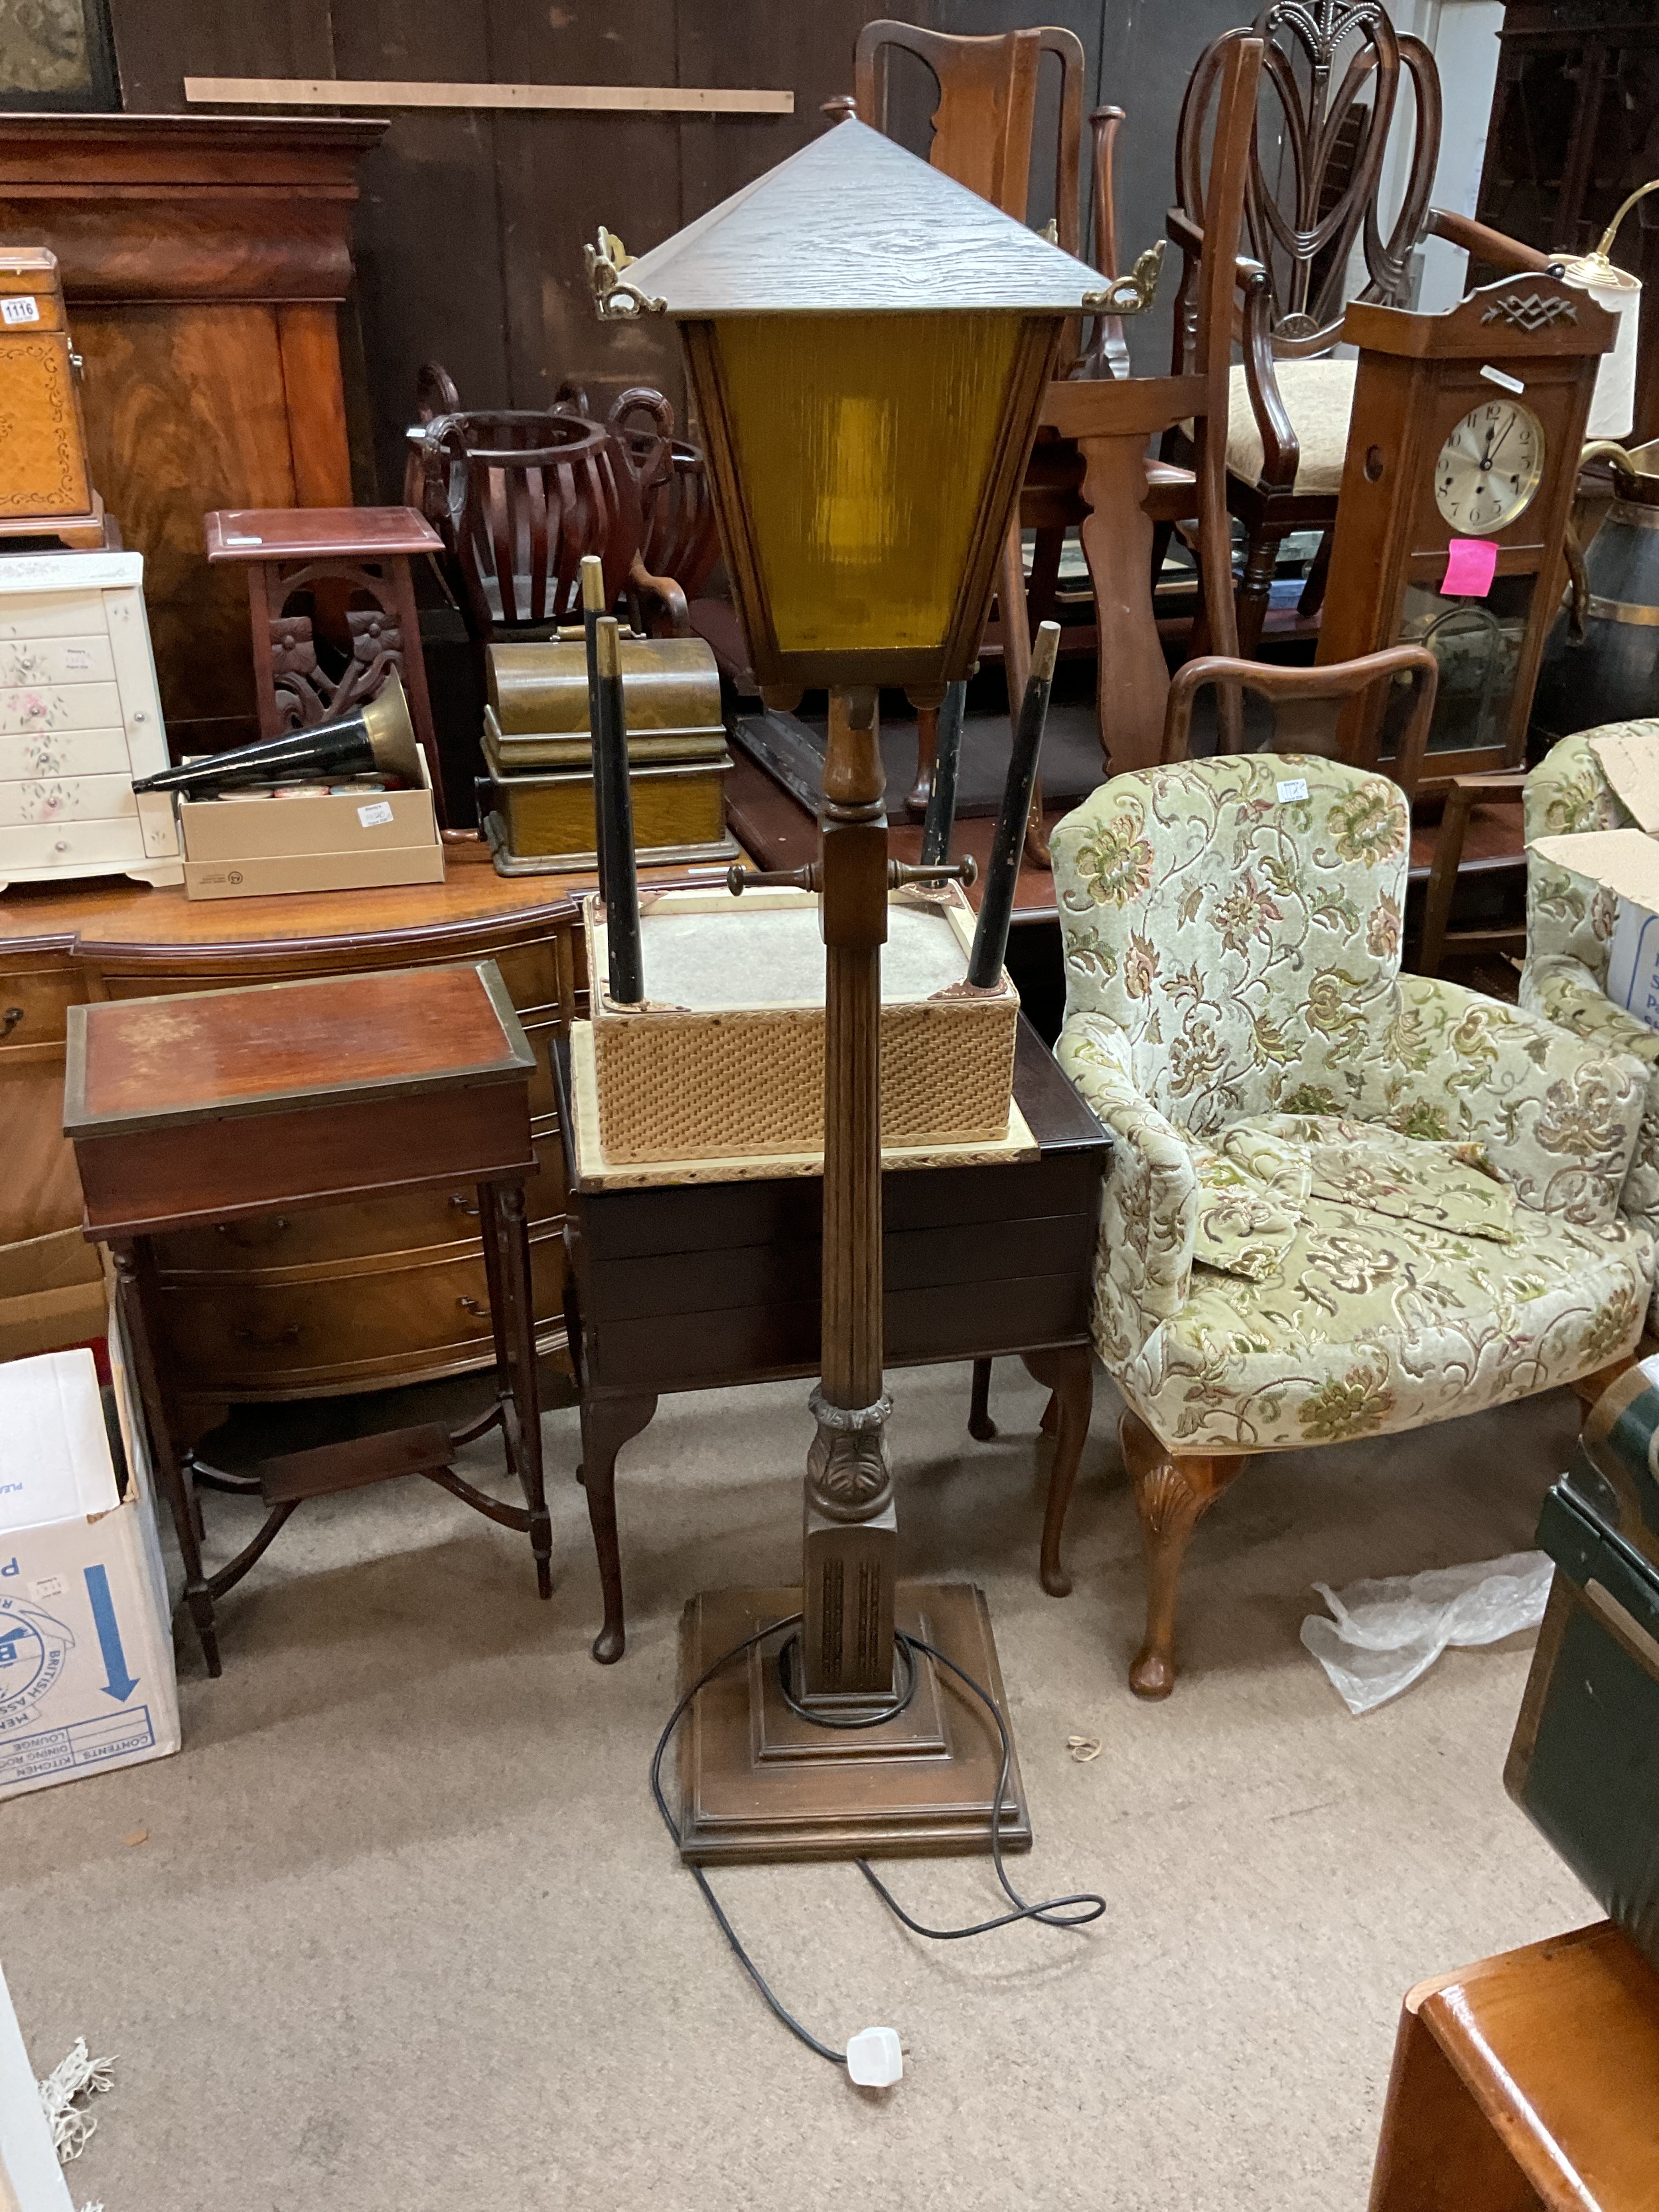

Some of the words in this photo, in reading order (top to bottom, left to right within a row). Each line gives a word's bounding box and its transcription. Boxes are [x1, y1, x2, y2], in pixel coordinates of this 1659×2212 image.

[6, 303, 33, 317] 1116
[1486, 404, 1501, 420] 12
[1467, 413, 1477, 428] 11
[1447, 434, 1461, 447] 10
[1438, 459, 1449, 473] 9
[1437, 486, 1448, 498] 8
[1451, 502, 1460, 516] 7
[27, 1650, 60, 1698] BRITISH
[13, 1732, 66, 1751] LOUNGE
[83, 1735, 149, 1759] CONTENTS
[27, 1745, 70, 1759] DINING
[17, 1757, 71, 1777] KITCHEN
